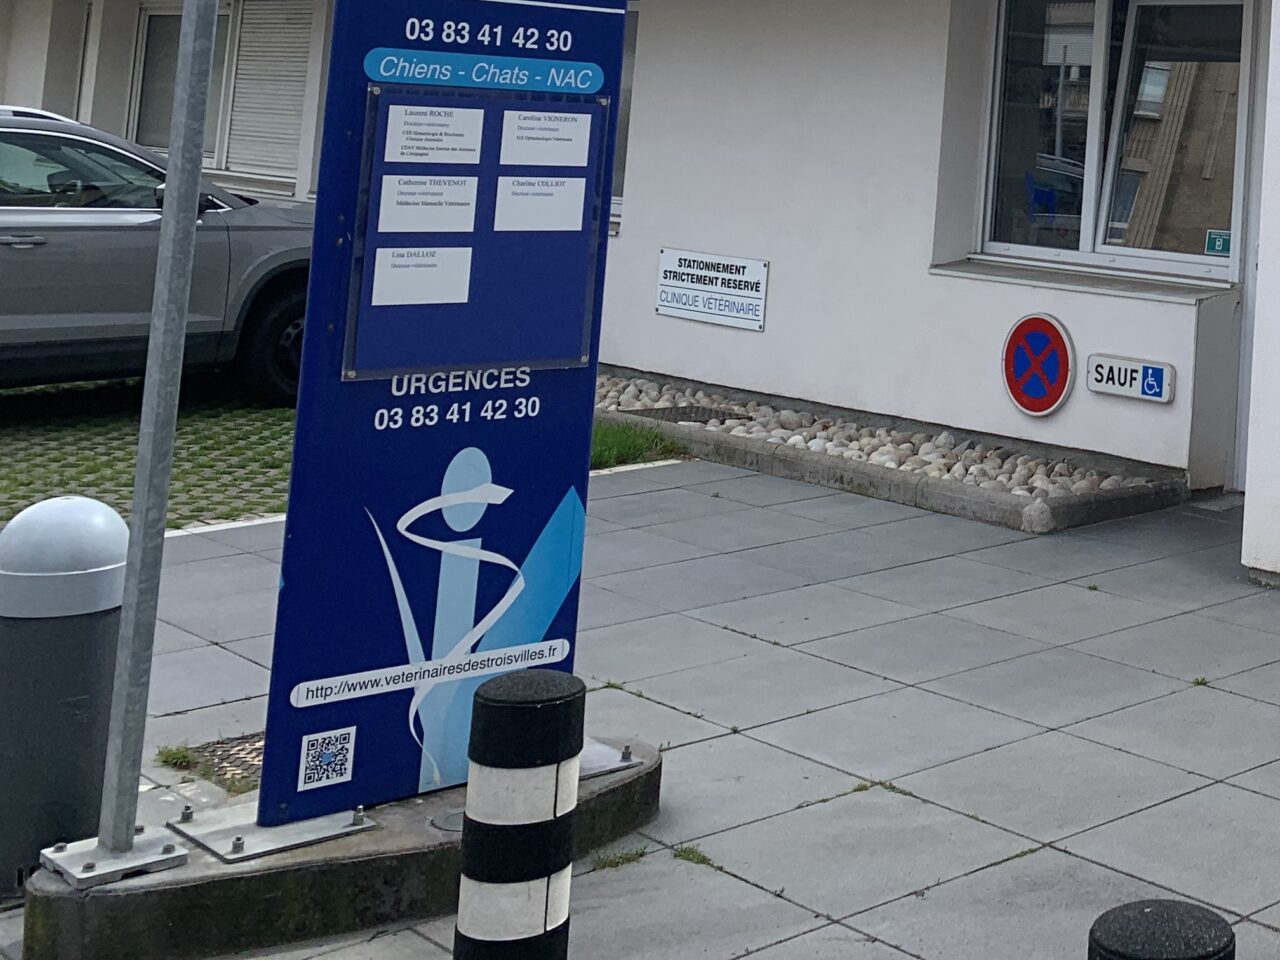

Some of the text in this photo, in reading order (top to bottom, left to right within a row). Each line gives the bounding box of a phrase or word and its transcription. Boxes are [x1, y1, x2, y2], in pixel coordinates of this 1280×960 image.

[405, 17, 573, 52] 03 83 41 42 30
[379, 56, 451, 81] Chiens
[471, 62, 529, 85] Chats
[546, 68, 592, 89] NAC
[663, 269, 719, 287] STRICTEMENT
[678, 257, 746, 276] STATIONNEMENT
[660, 290, 760, 317] CLINIQUE VÉTÉRINAIRE
[391, 367, 530, 396] URGENCES
[1094, 363, 1138, 388] SAUF
[374, 397, 540, 430] 03 83 41 42 30
[306, 646, 558, 701] http://www.veterinairesdestroisvilles.fr
